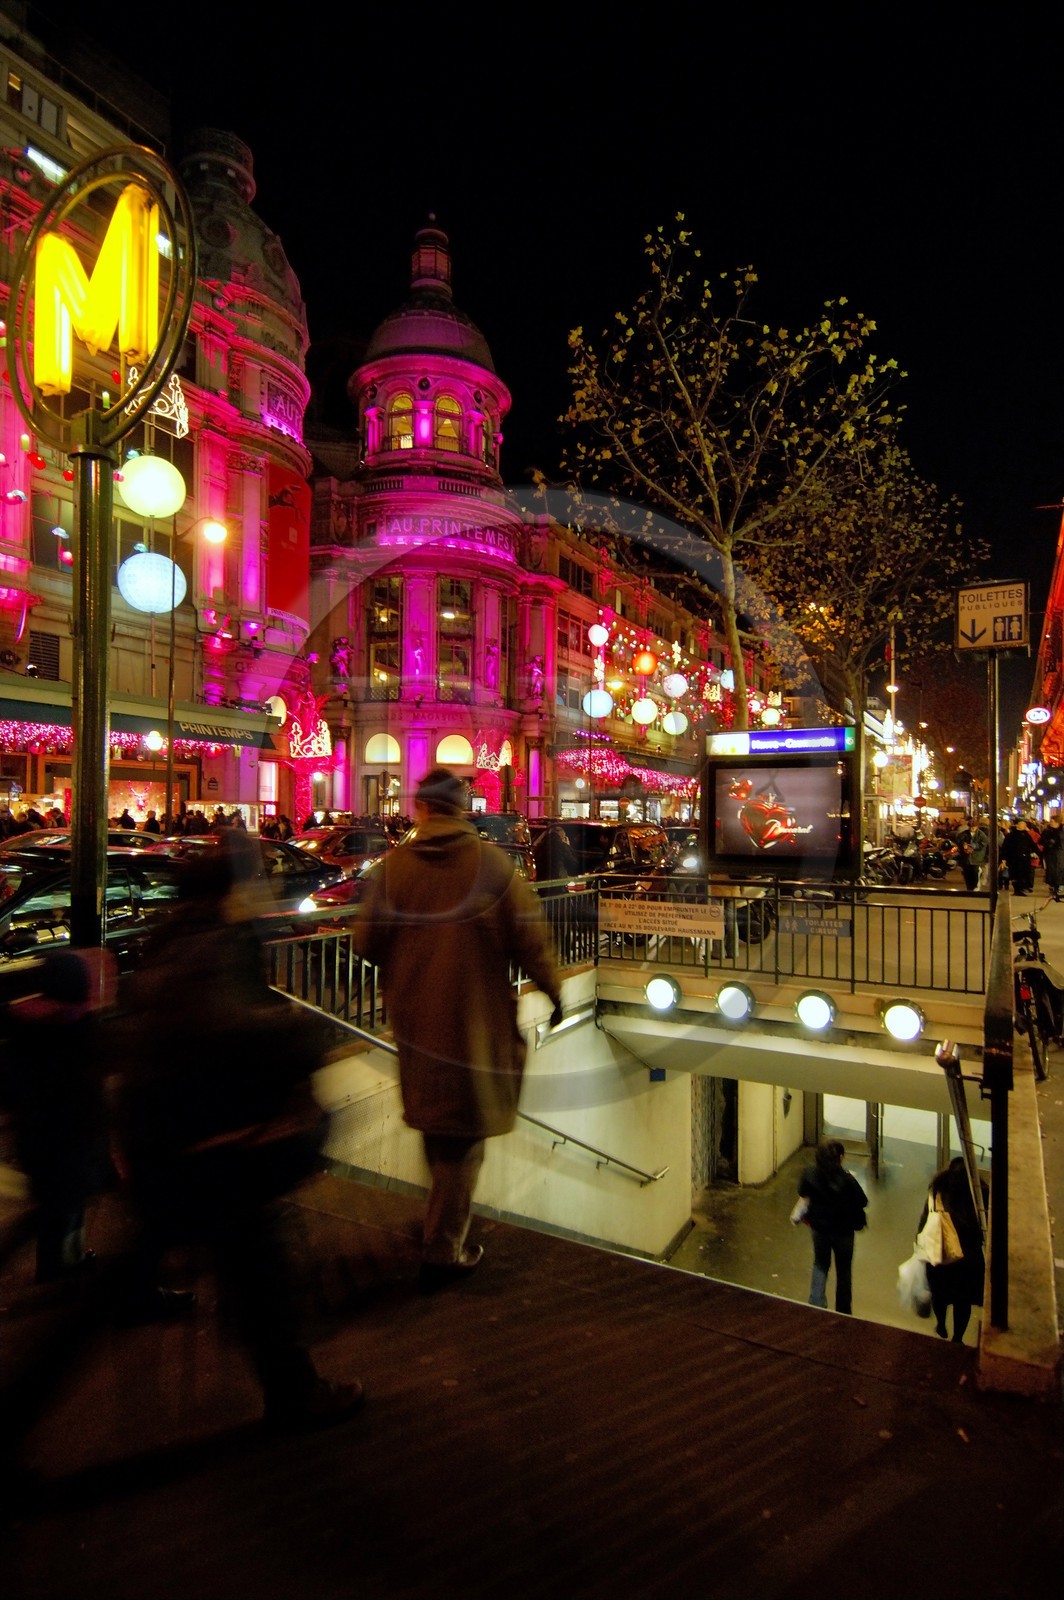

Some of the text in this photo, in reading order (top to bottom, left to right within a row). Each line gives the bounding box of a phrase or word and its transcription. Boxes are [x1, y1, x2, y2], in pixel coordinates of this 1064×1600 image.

[33, 183, 160, 397] M
[390, 518, 510, 550] AU PRINTEMPS
[959, 588, 1023, 604] TOILETTES
[959, 599, 1023, 612] PUBLIQUES
[178, 721, 254, 740] PRINTEMPS
[663, 906, 699, 914] EMPRUNTER
[643, 925, 676, 933] BOULEVARD
[677, 928, 716, 936] HAUSSMANN
